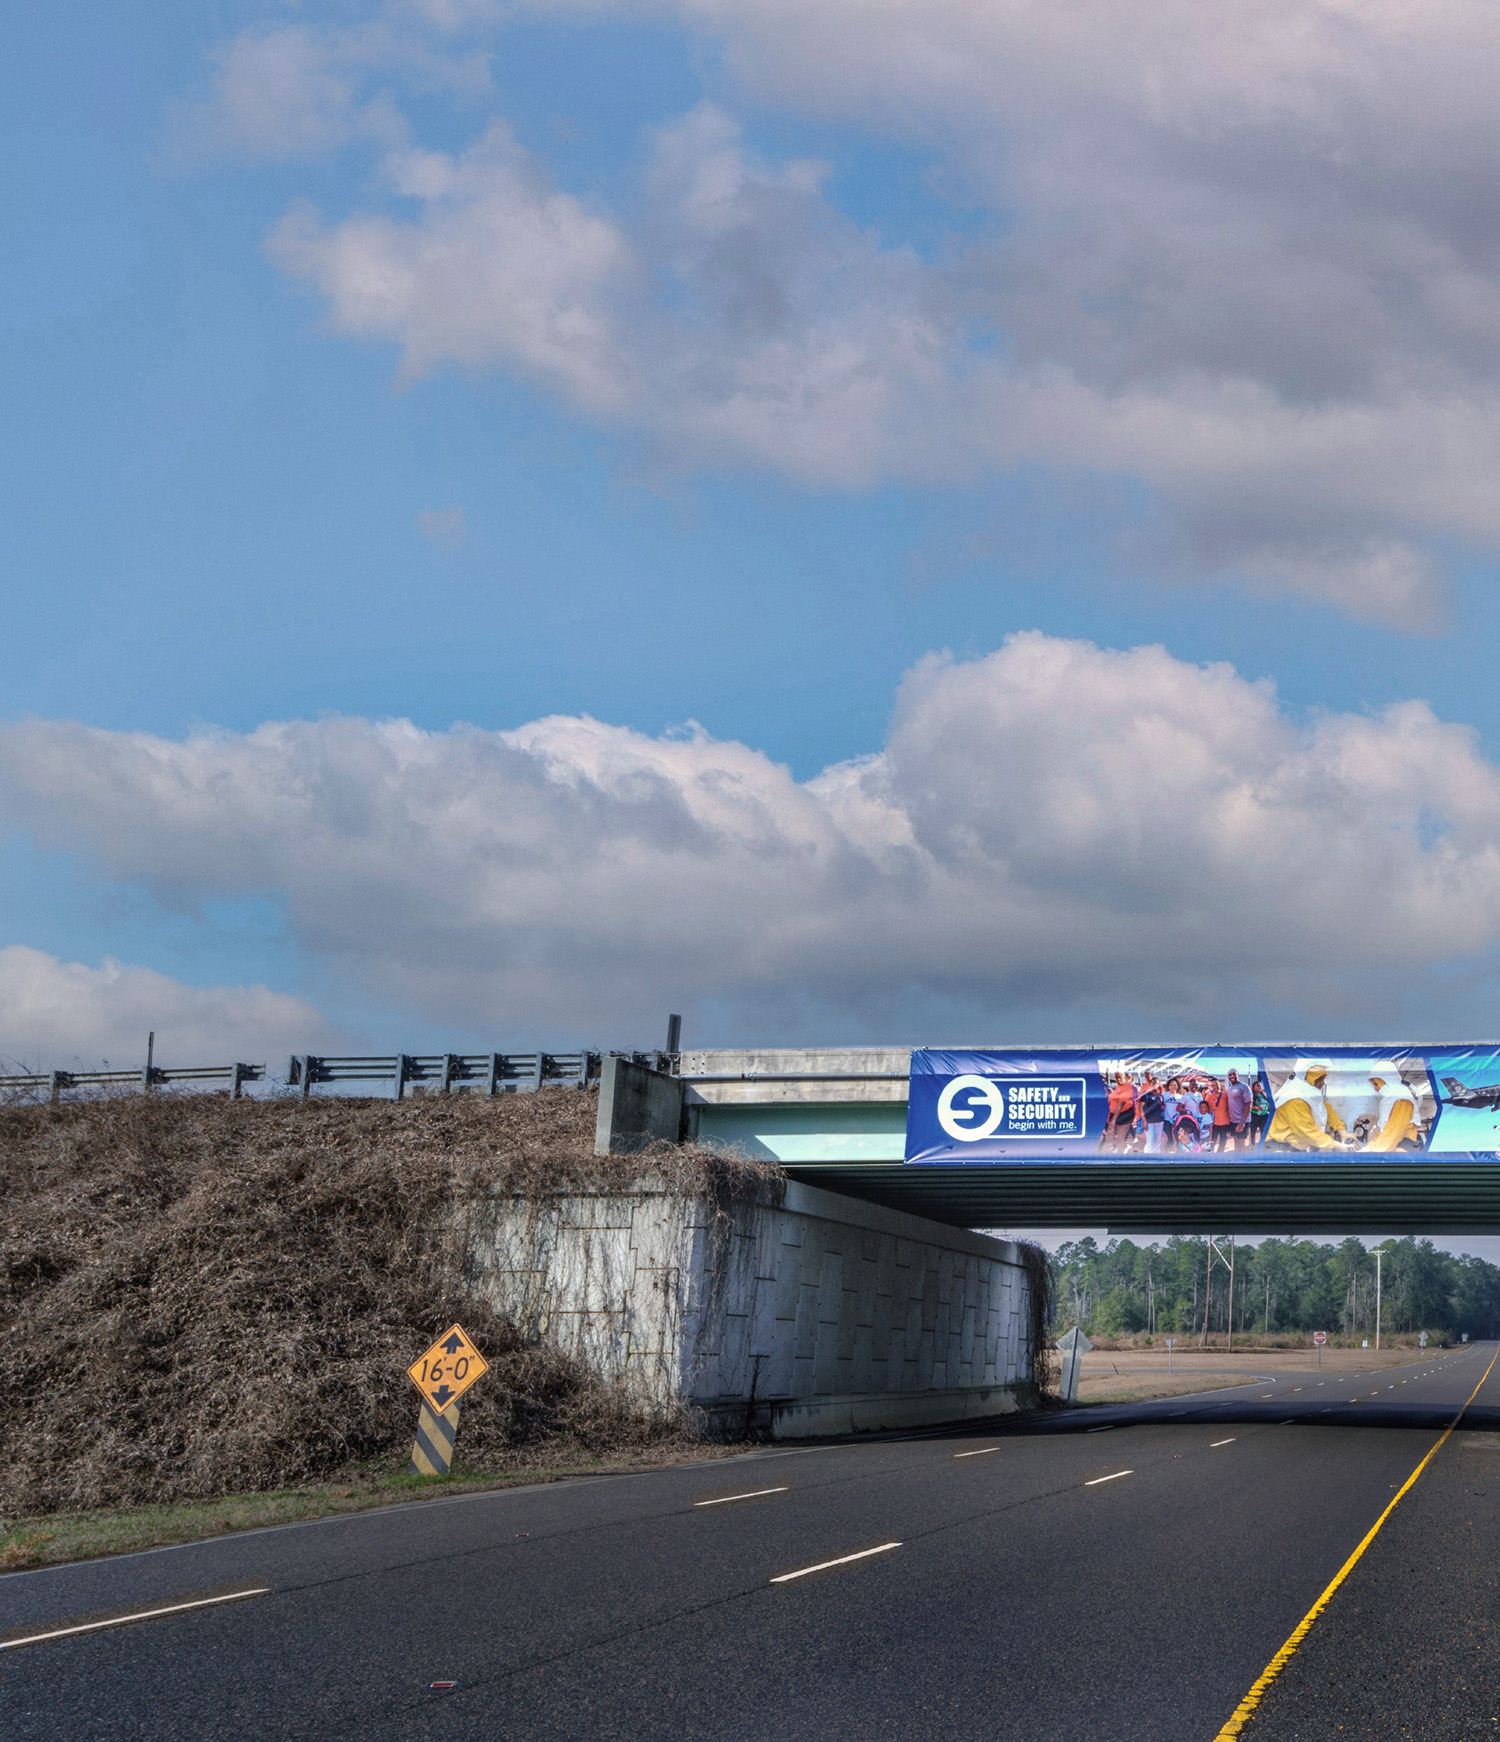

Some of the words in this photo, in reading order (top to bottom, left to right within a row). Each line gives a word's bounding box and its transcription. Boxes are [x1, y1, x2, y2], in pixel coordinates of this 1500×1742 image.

[1008, 1086, 1059, 1103] SAFETY
[1008, 1103, 1077, 1120] SECURITY
[1008, 1120, 1035, 1131] begin
[1037, 1120, 1057, 1130] with
[1059, 1121, 1077, 1130] me.
[421, 1355, 476, 1382] 16'-0"
